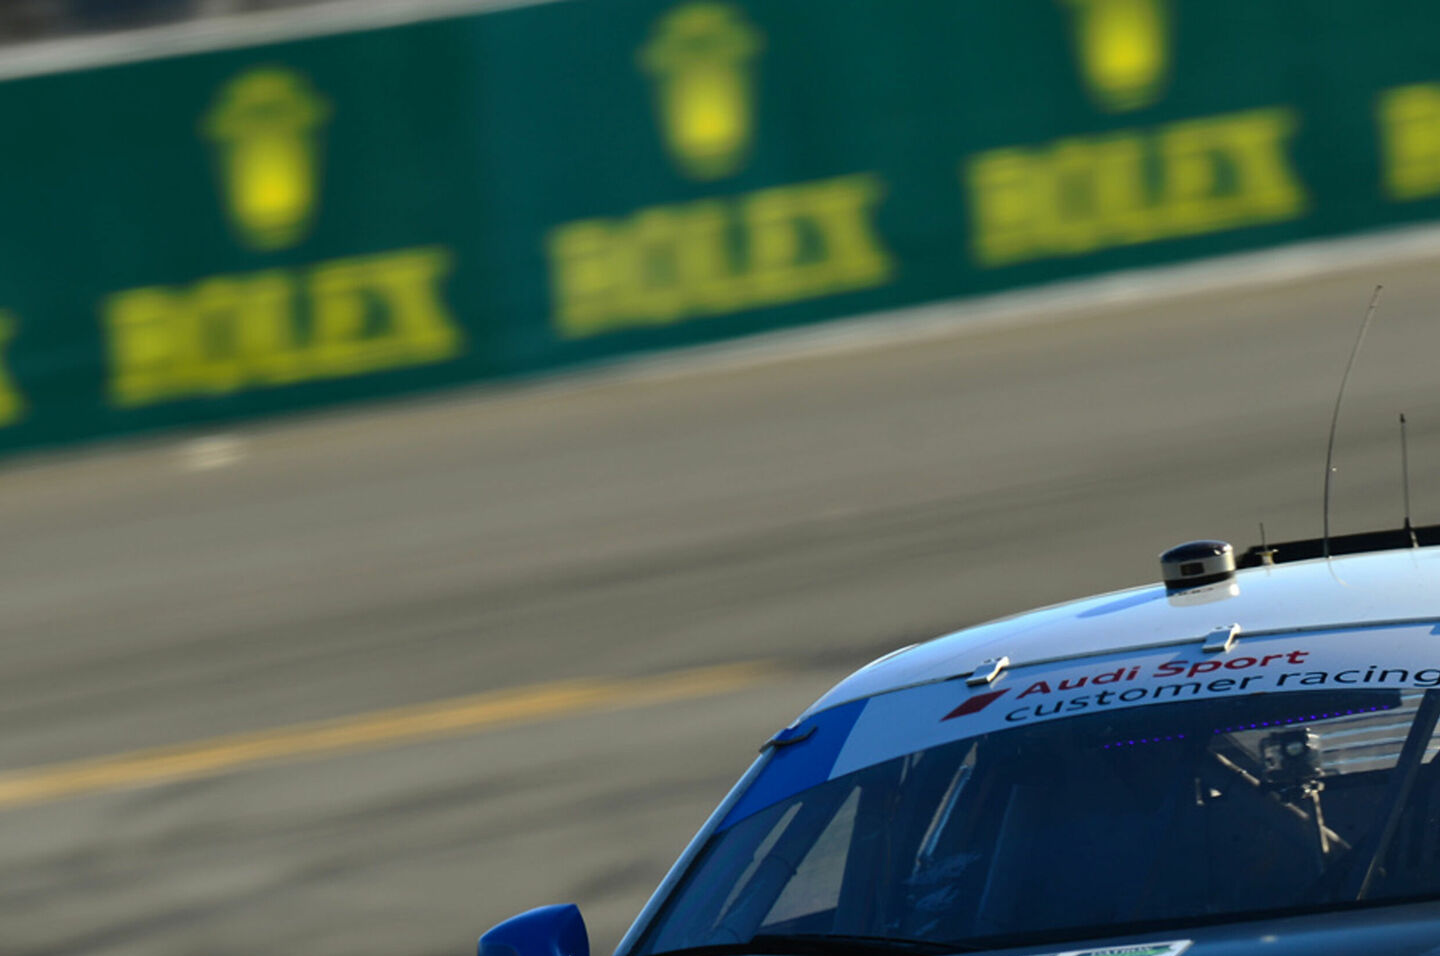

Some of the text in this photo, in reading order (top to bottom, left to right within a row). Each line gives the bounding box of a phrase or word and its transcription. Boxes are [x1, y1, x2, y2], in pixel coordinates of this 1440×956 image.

[546, 173, 892, 340] ROLEX
[967, 108, 1305, 268] ROLEX
[106, 248, 463, 408] ROLEX
[1004, 673, 1251, 723] customer
[1014, 650, 1310, 700] Audi Sport
